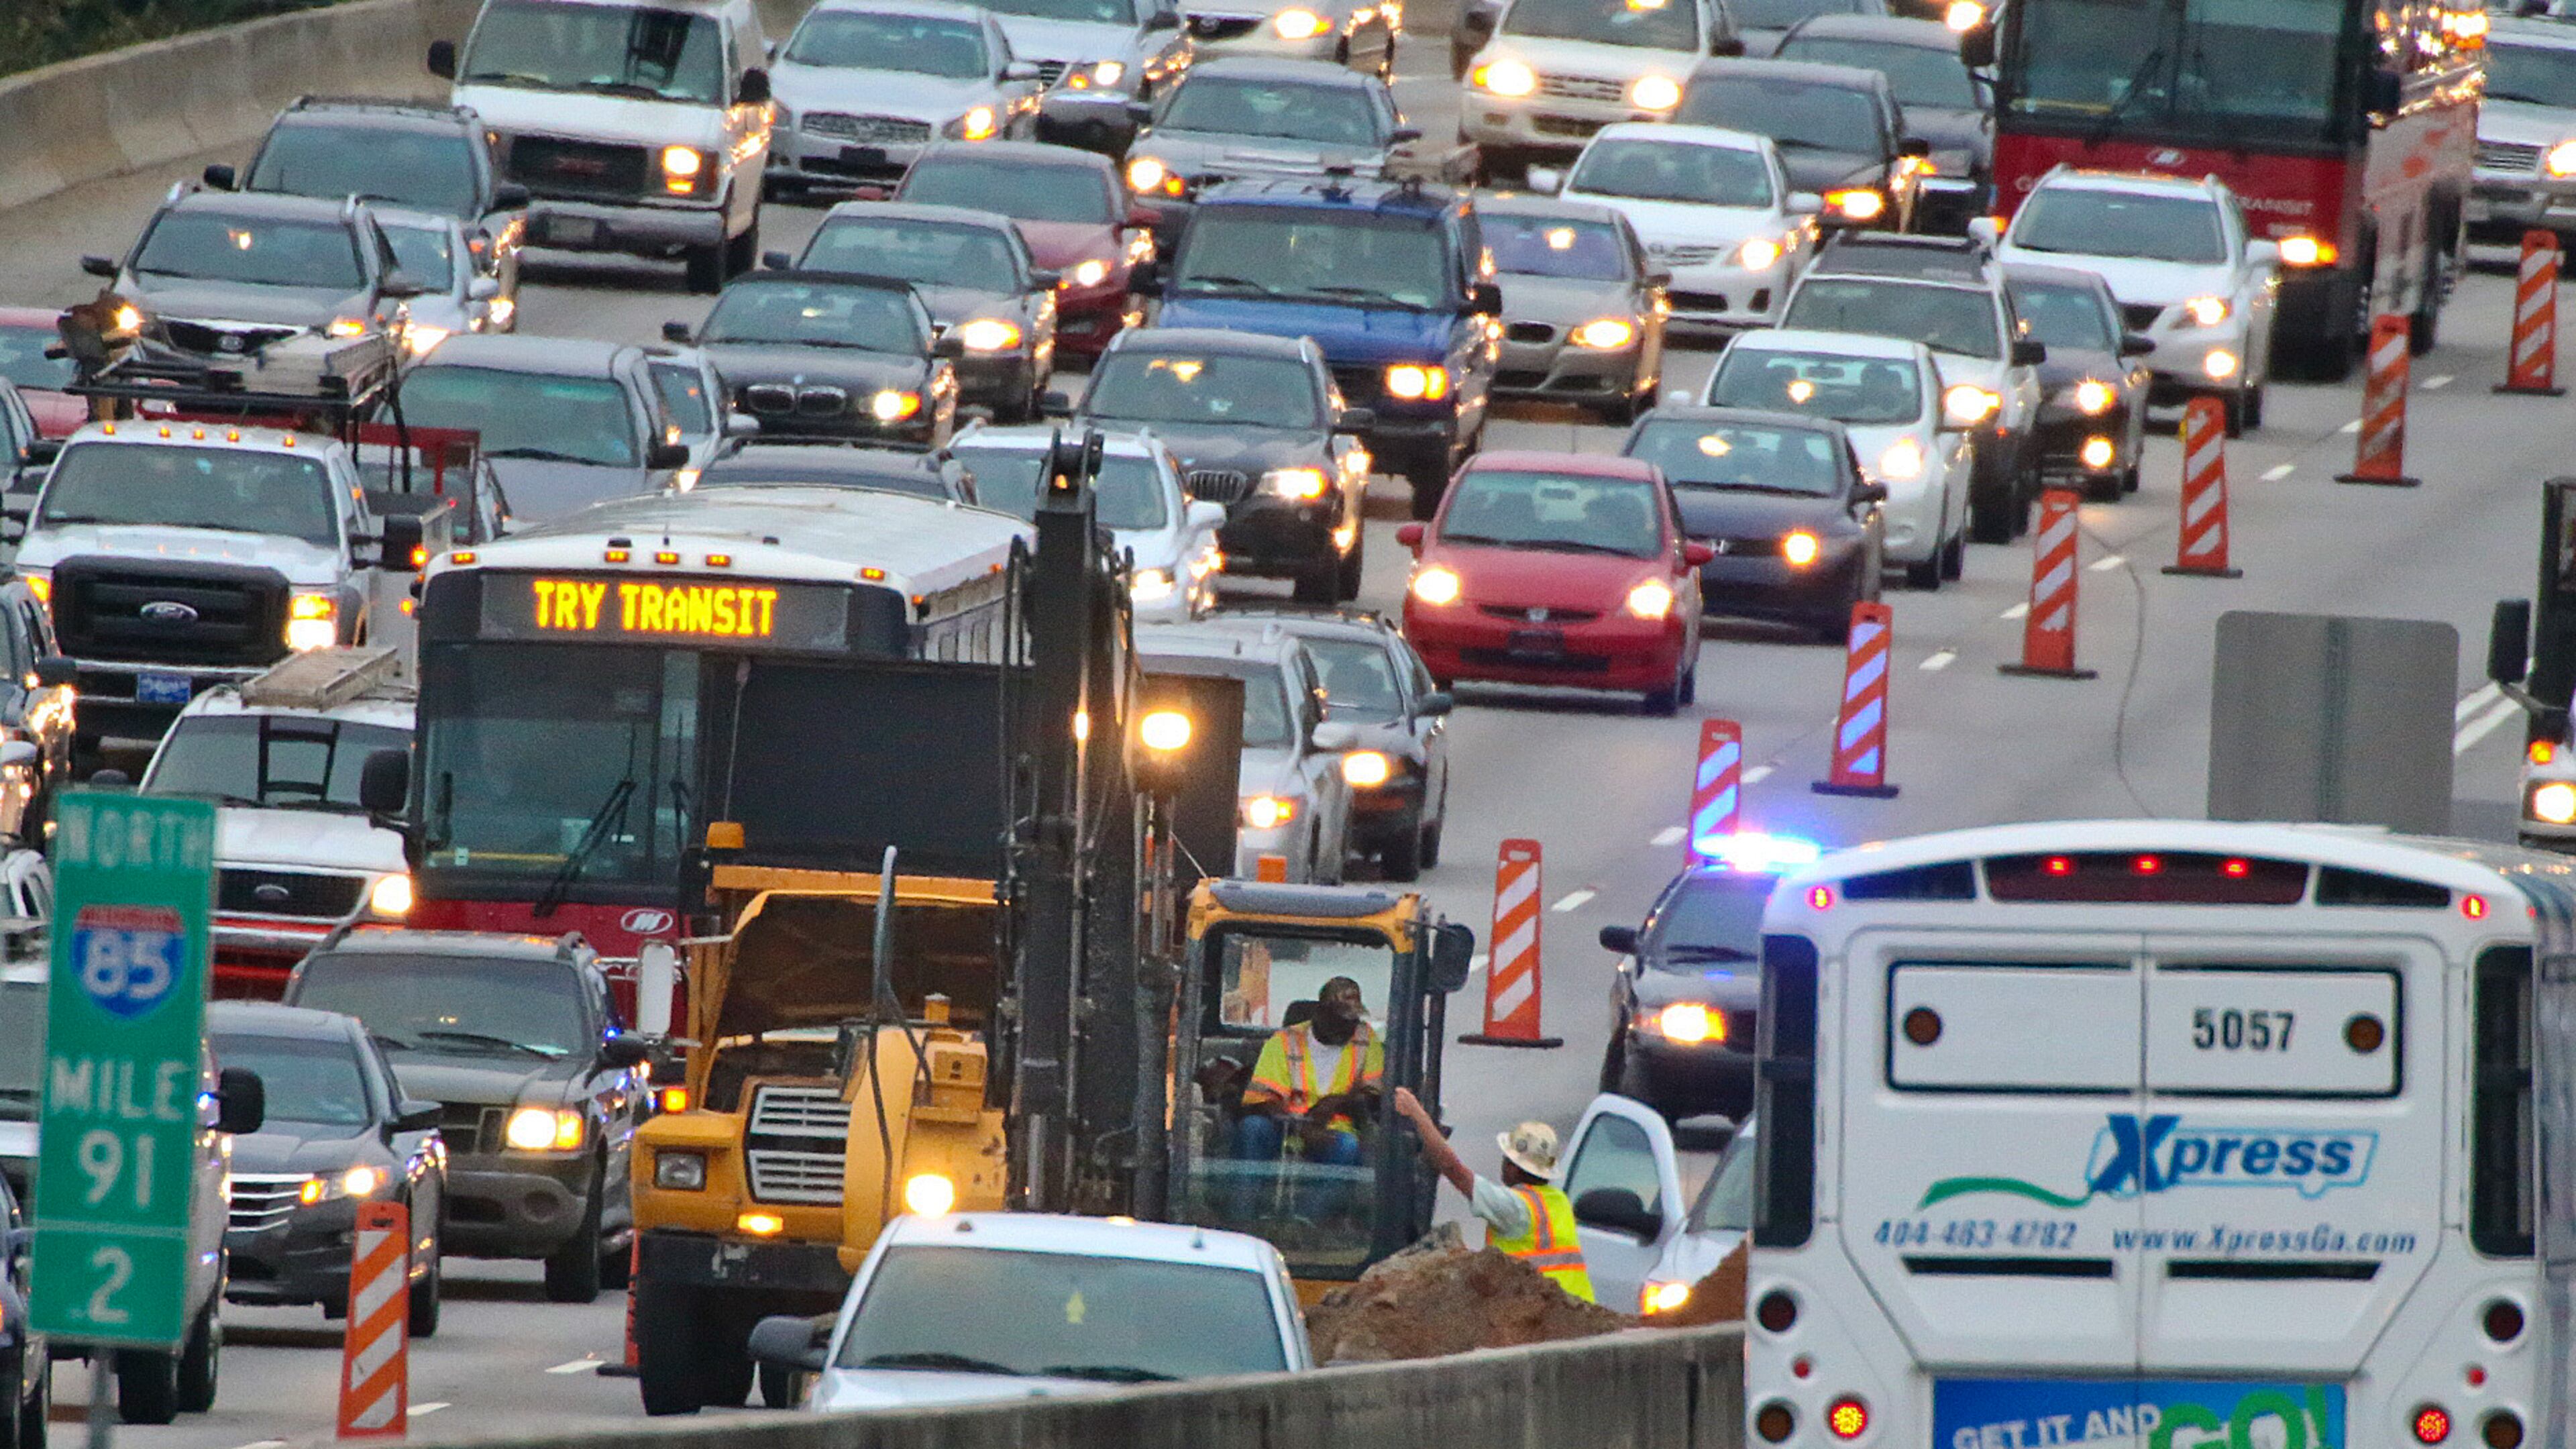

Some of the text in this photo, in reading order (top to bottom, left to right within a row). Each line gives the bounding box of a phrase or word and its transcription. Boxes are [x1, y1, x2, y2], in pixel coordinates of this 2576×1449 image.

[2232, 196, 2313, 215] RANSIT
[534, 580, 778, 636] TRY TRANSIT
[56, 805, 213, 869] NORTH
[83, 928, 170, 998] 85
[2192, 1008, 2295, 1051] 5057
[50, 1055, 193, 1120] MILE
[78, 1128, 156, 1208] 91
[2088, 1114, 2355, 1193] Xpress
[1952, 1420, 2026, 1449] GET
[2037, 1414, 2073, 1448] IT
[2083, 1403, 2161, 1440] AND
